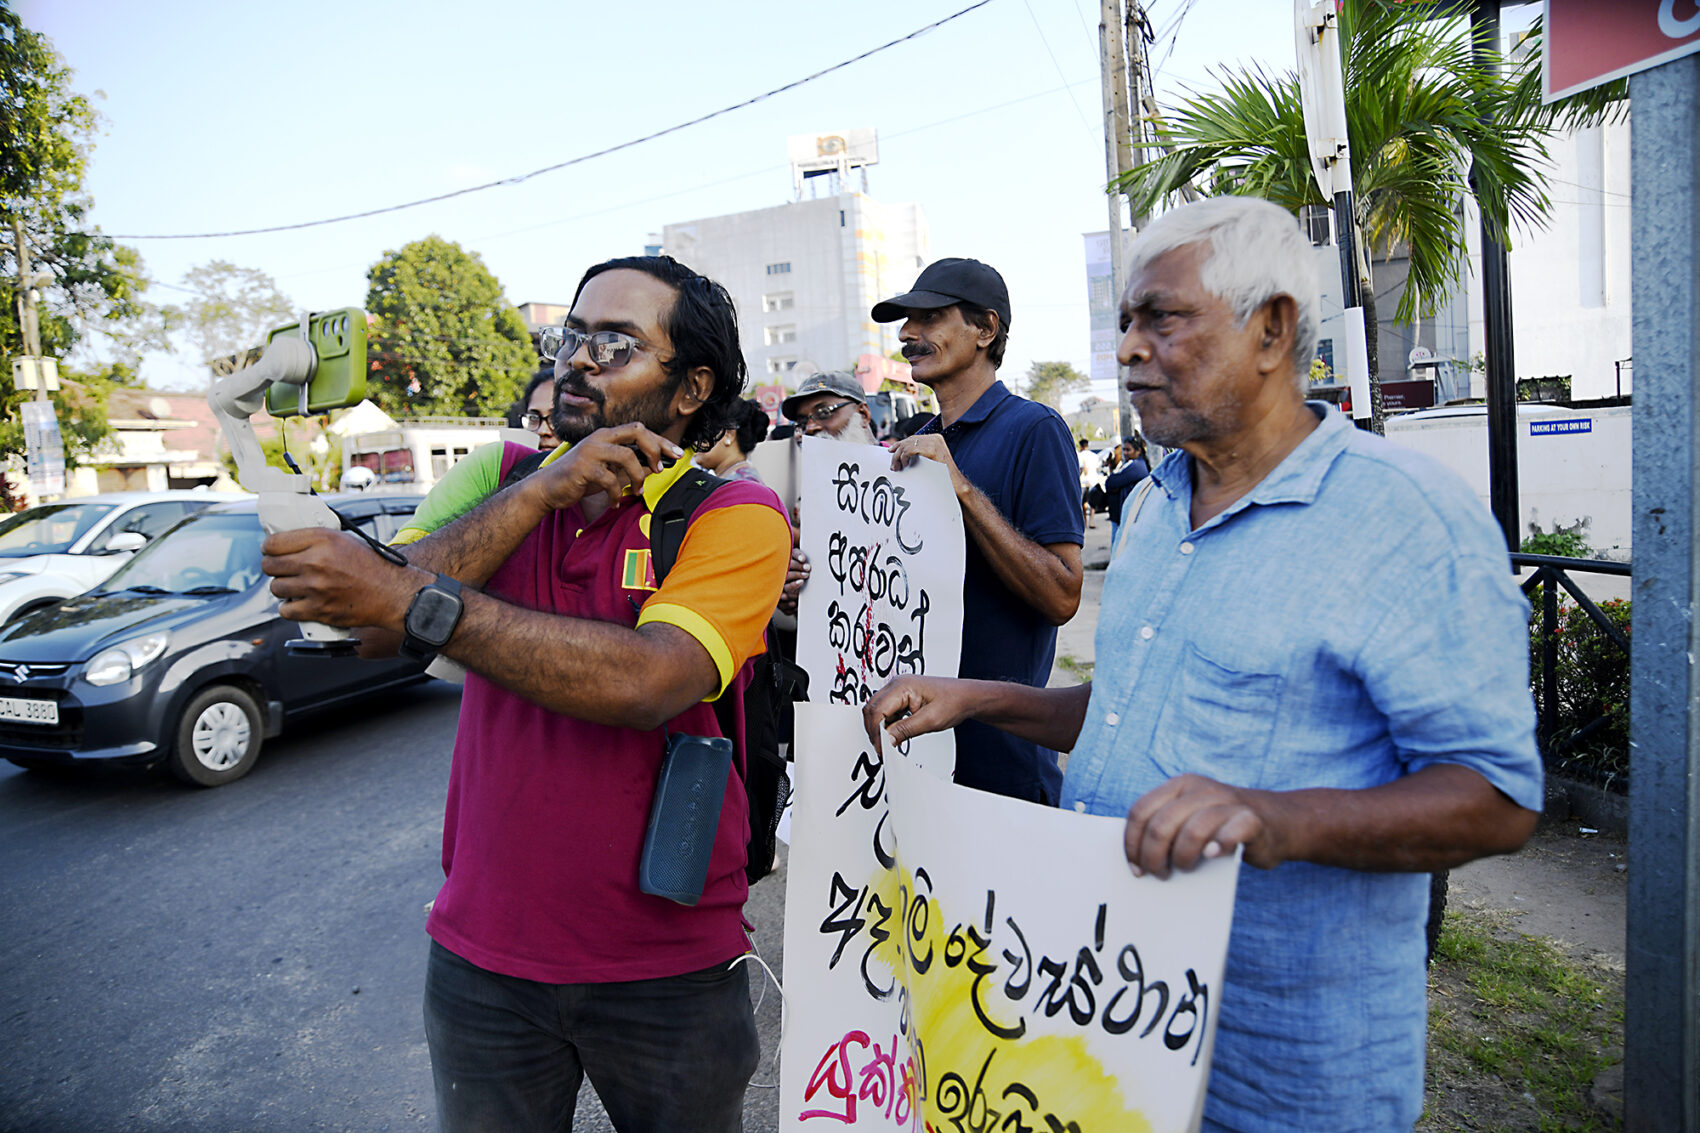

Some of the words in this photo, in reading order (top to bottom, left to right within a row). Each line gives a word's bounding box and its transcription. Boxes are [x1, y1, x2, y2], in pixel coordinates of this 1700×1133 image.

[1531, 424, 1550, 433] PARKING
[1551, 424, 1556, 432] AT
[1557, 423, 1569, 431] YOUR
[1569, 422, 1579, 430] OWN
[1580, 422, 1590, 430] RISK
